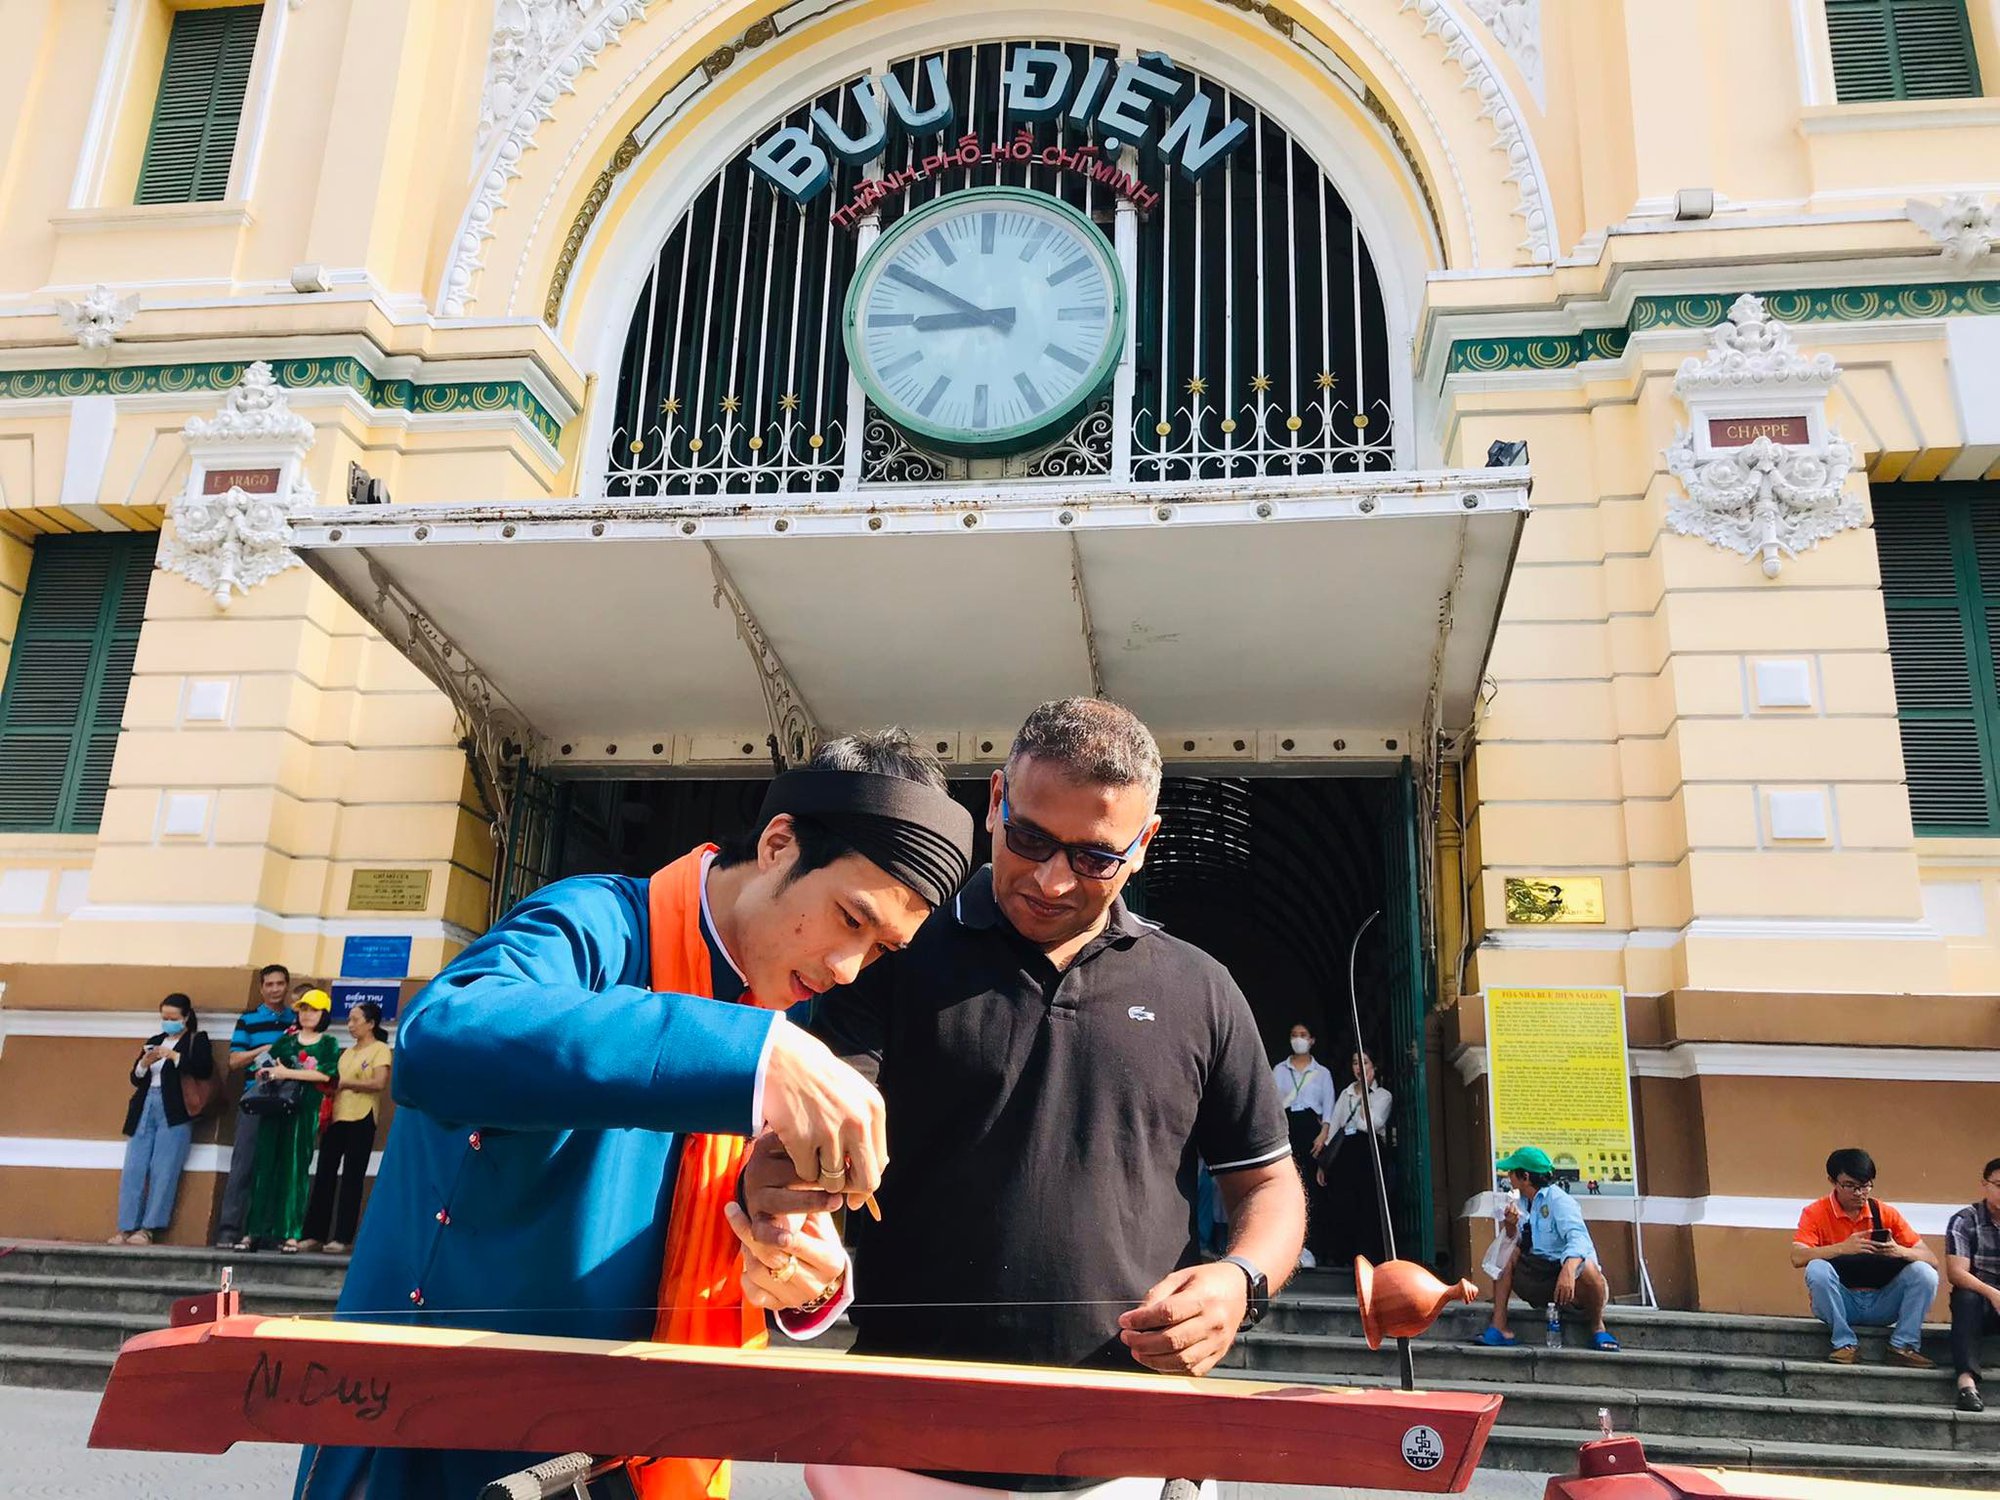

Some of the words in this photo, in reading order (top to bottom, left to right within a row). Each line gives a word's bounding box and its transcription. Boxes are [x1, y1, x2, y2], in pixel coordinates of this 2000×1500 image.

[747, 56, 953, 200] BƯU
[1004, 47, 1249, 180] ĐIỆN
[830, 164, 918, 226] THÀNH
[921, 131, 981, 178] PHỐ
[991, 130, 1034, 161] HỒ
[1091, 163, 1160, 209] MINH
[1726, 424, 1790, 439] CHAPPE
[228, 474, 269, 486] ARAGO
